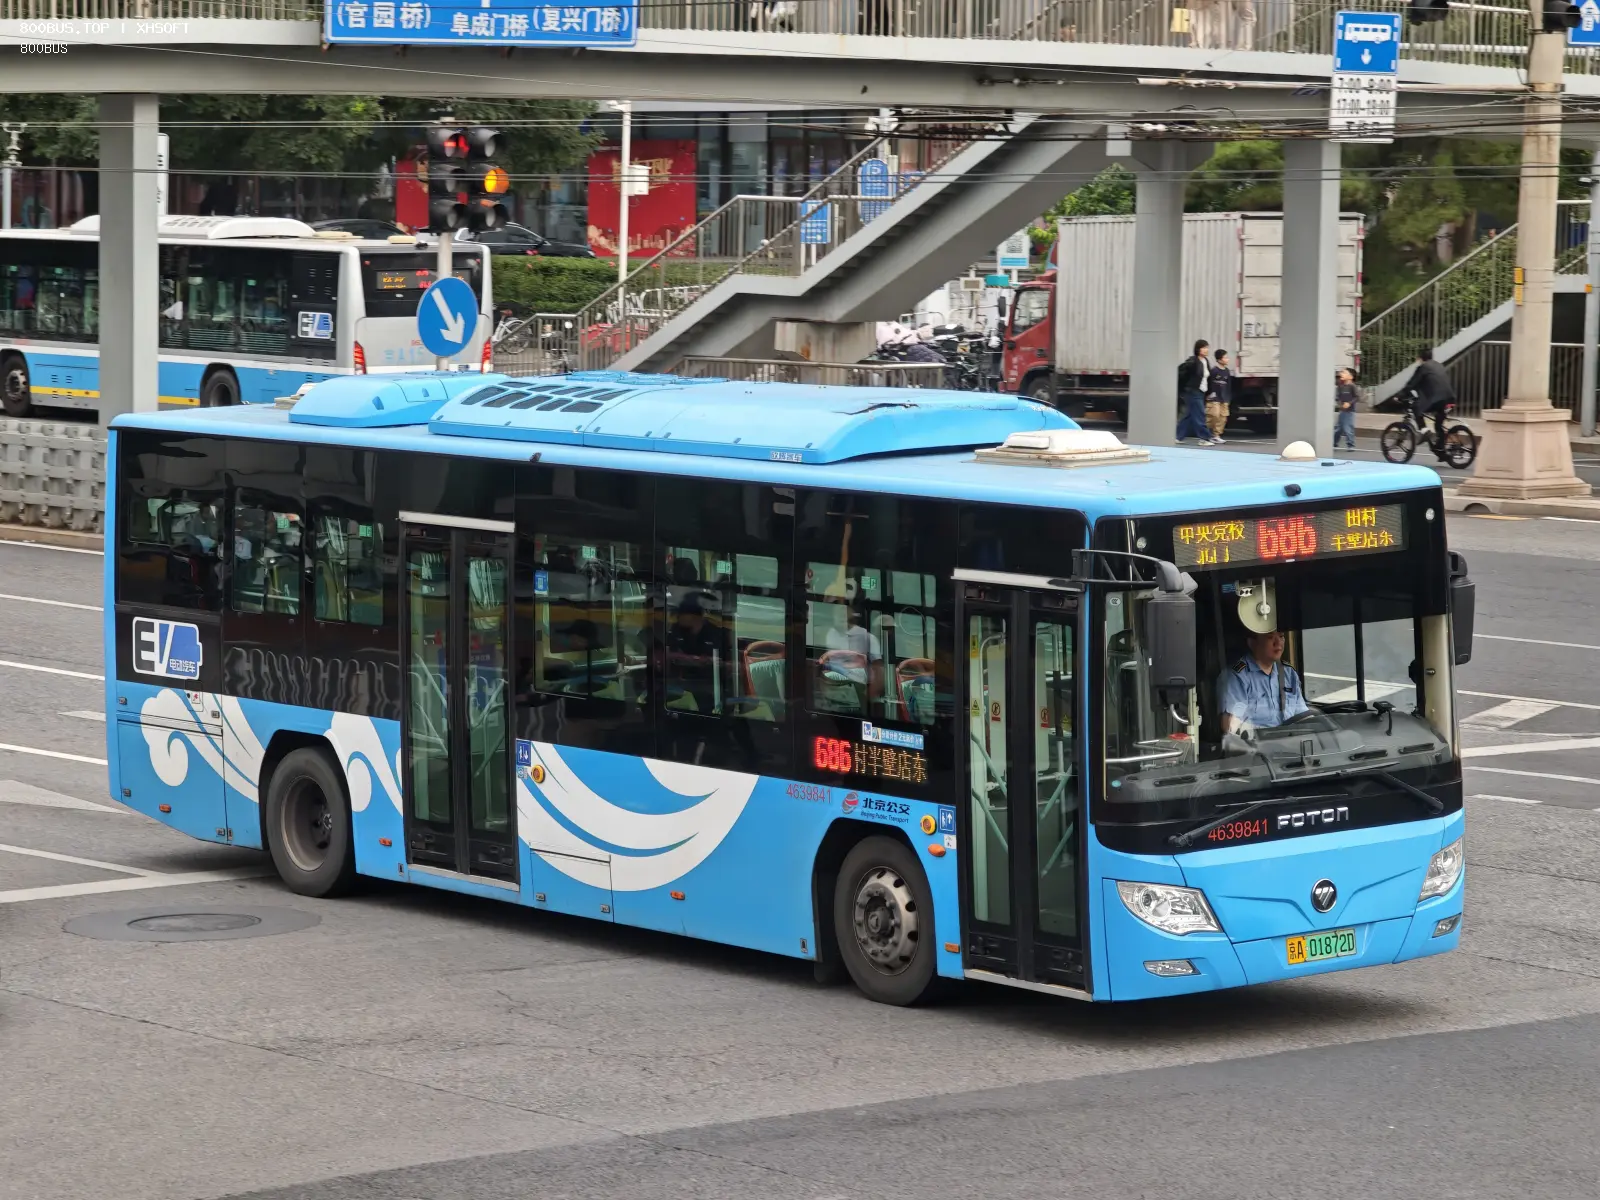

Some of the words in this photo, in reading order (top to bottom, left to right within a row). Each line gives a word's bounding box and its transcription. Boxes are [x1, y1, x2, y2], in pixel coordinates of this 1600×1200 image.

[1346, 507, 1378, 528] 田村
[1258, 515, 1317, 558] 686
[814, 736, 852, 772] 686
[786, 783, 832, 804] 4639841
[862, 797, 911, 816] 北京公交
[1207, 818, 1268, 842] 4639841
[1276, 806, 1350, 830] FOTON
